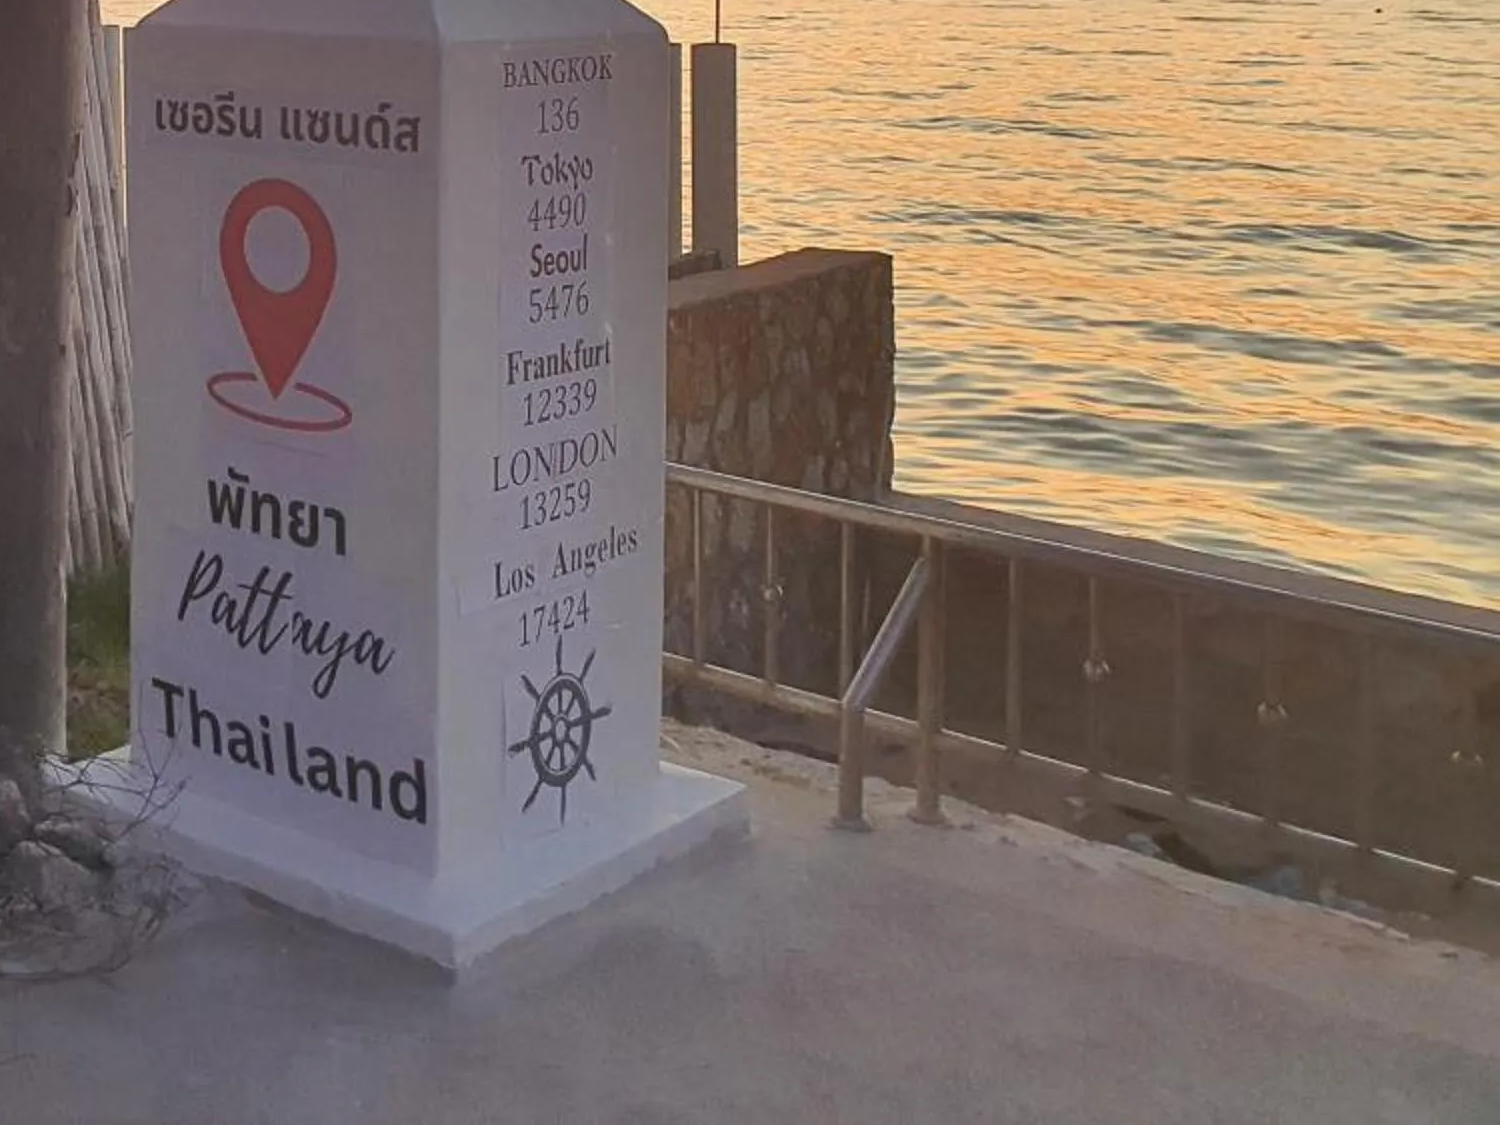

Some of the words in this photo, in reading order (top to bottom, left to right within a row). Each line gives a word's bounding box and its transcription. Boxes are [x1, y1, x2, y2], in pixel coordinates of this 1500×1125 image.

[502, 54, 613, 88] BANGKOK
[155, 90, 263, 140] เซอรีน
[280, 101, 421, 152] แซนด์ส
[538, 96, 580, 134] 136
[521, 152, 593, 191] Tokyo
[527, 192, 587, 232] 4490
[529, 233, 588, 277] Seoul
[529, 280, 589, 324] 5476
[506, 337, 611, 386] Frankfurt
[523, 378, 598, 426] 12339
[492, 425, 618, 492] LONDON
[208, 468, 347, 556] พัทยา
[520, 478, 592, 530] 13259
[495, 561, 536, 599] Los
[551, 525, 639, 579] Angeles
[519, 589, 591, 647] 17424
[151, 677, 428, 825] Thailand
